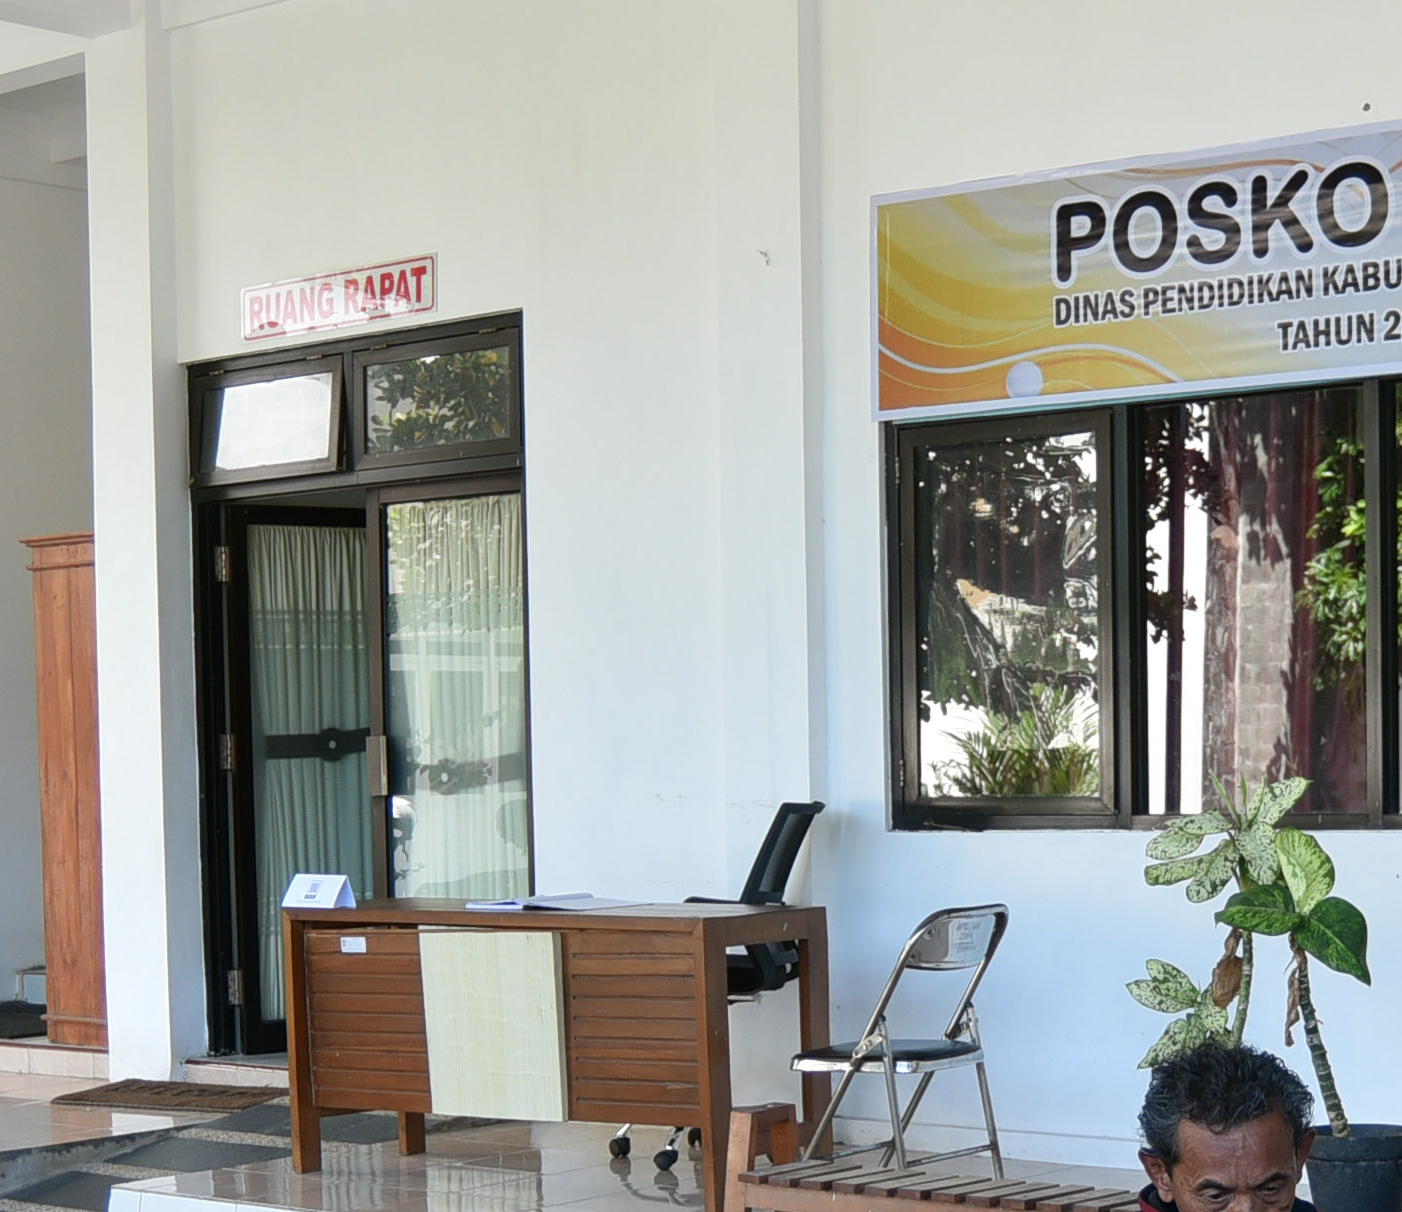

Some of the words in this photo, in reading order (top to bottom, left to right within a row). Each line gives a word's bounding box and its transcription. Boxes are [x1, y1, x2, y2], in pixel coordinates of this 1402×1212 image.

[1055, 161, 1390, 283] POSKO
[249, 282, 335, 333] RUANG
[343, 265, 428, 315] RAPAT
[1054, 289, 1136, 326] DINAS
[1142, 268, 1314, 316] PENDIDIKAN
[1277, 312, 1376, 351] TAHUN
